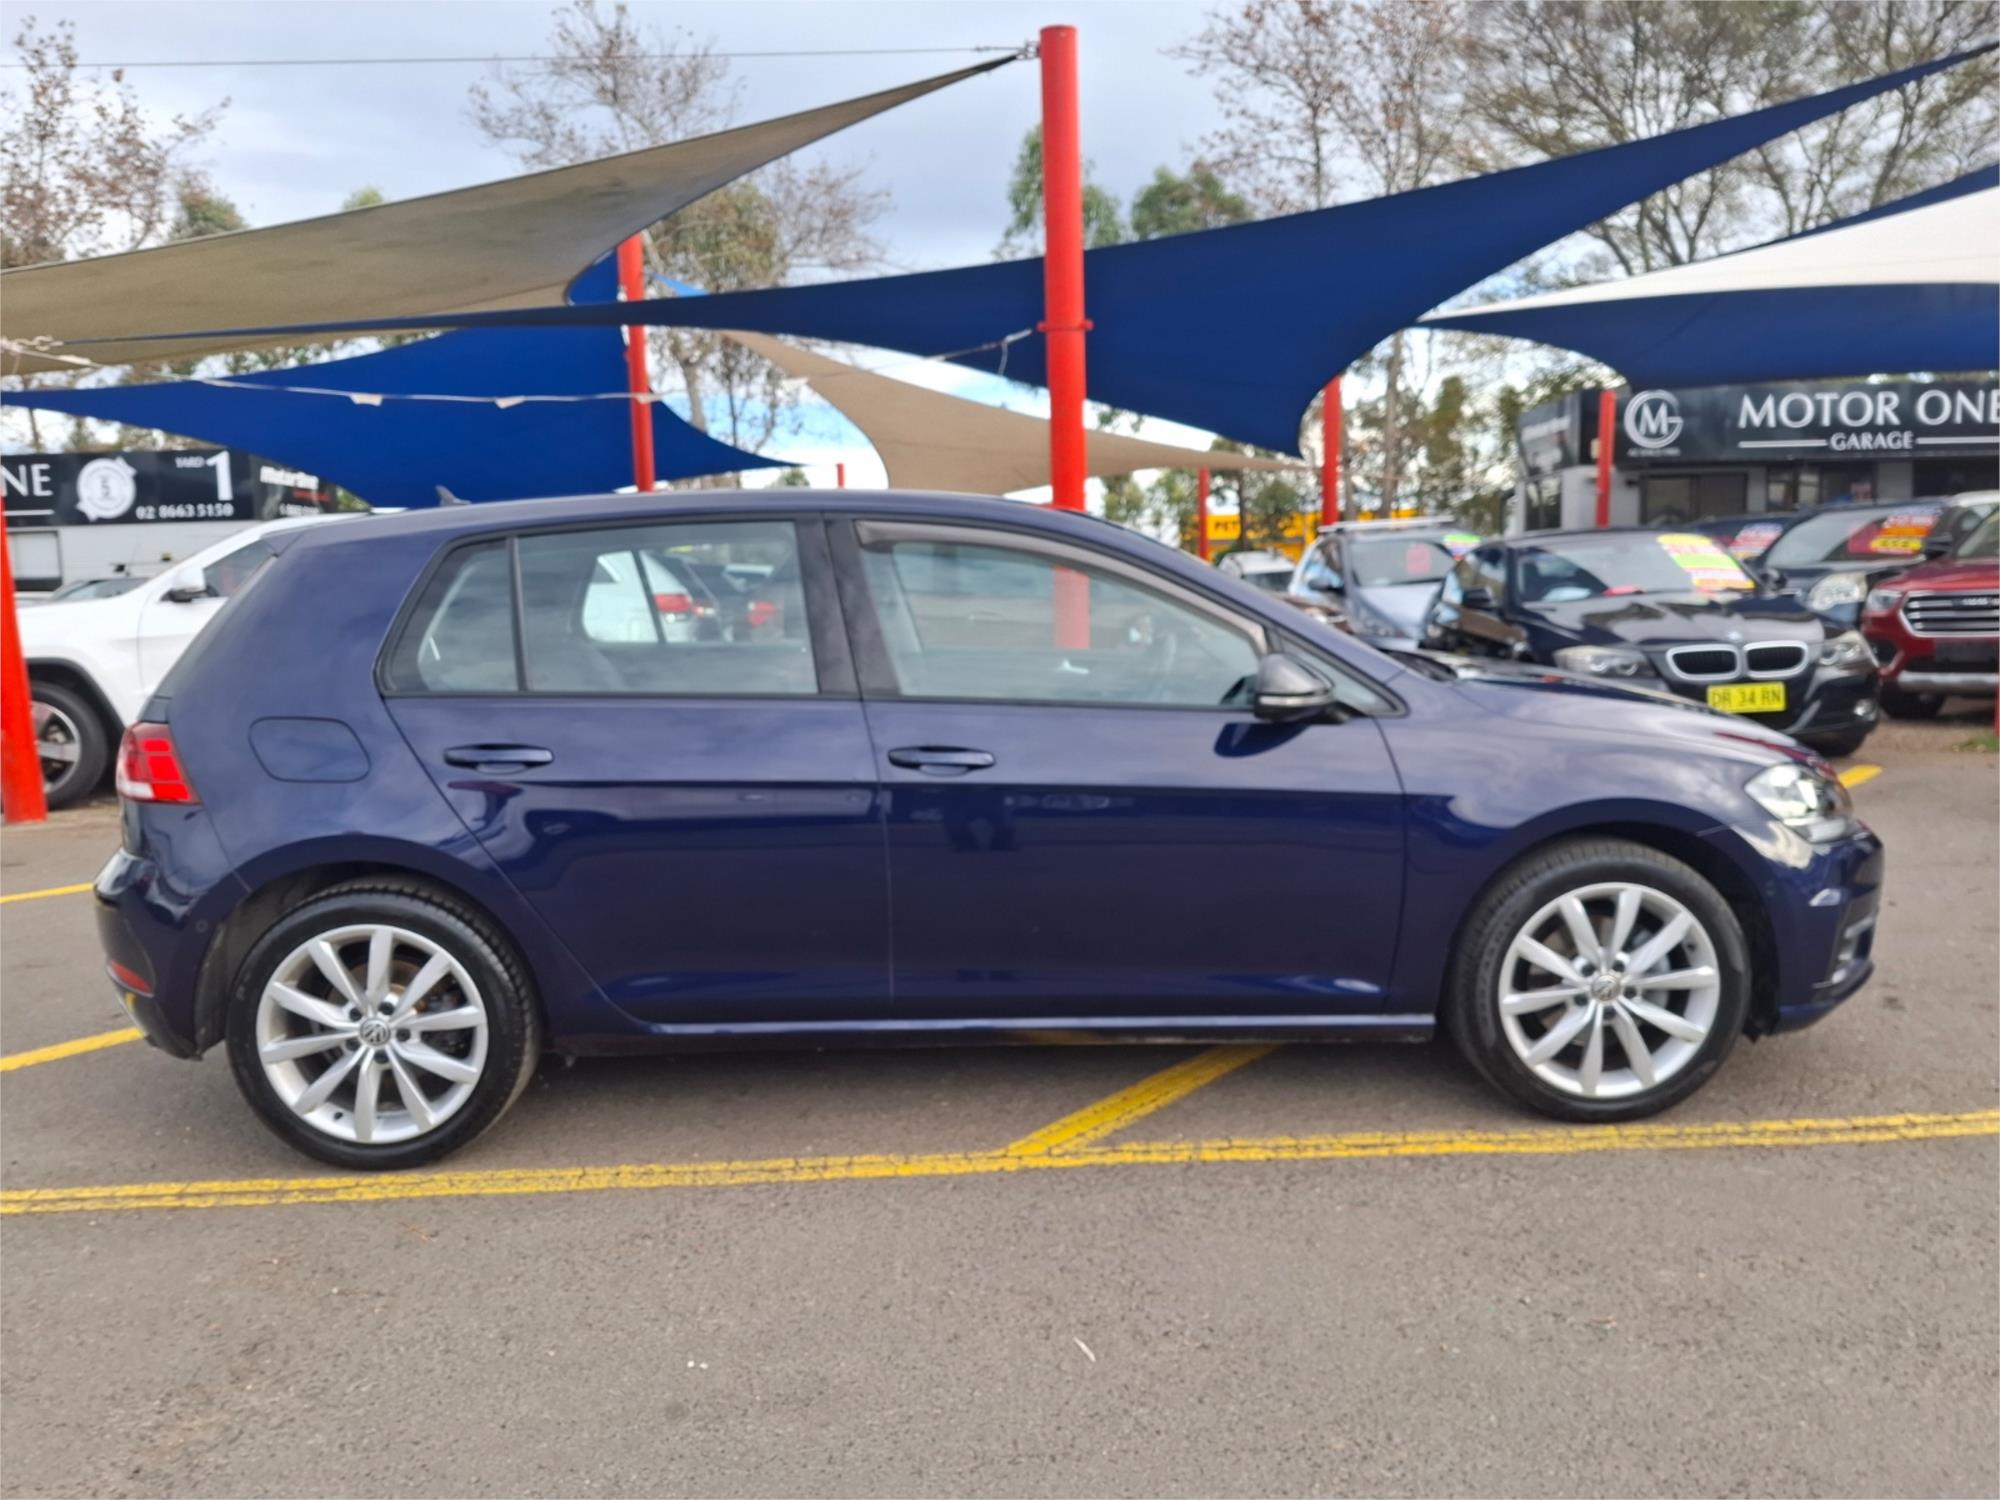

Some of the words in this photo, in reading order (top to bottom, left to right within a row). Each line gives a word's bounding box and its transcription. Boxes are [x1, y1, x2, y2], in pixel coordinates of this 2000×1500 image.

[1738, 391, 1901, 429] MOTOR
[1829, 431, 1914, 451] GARAGE
[205, 449, 233, 501] 1
